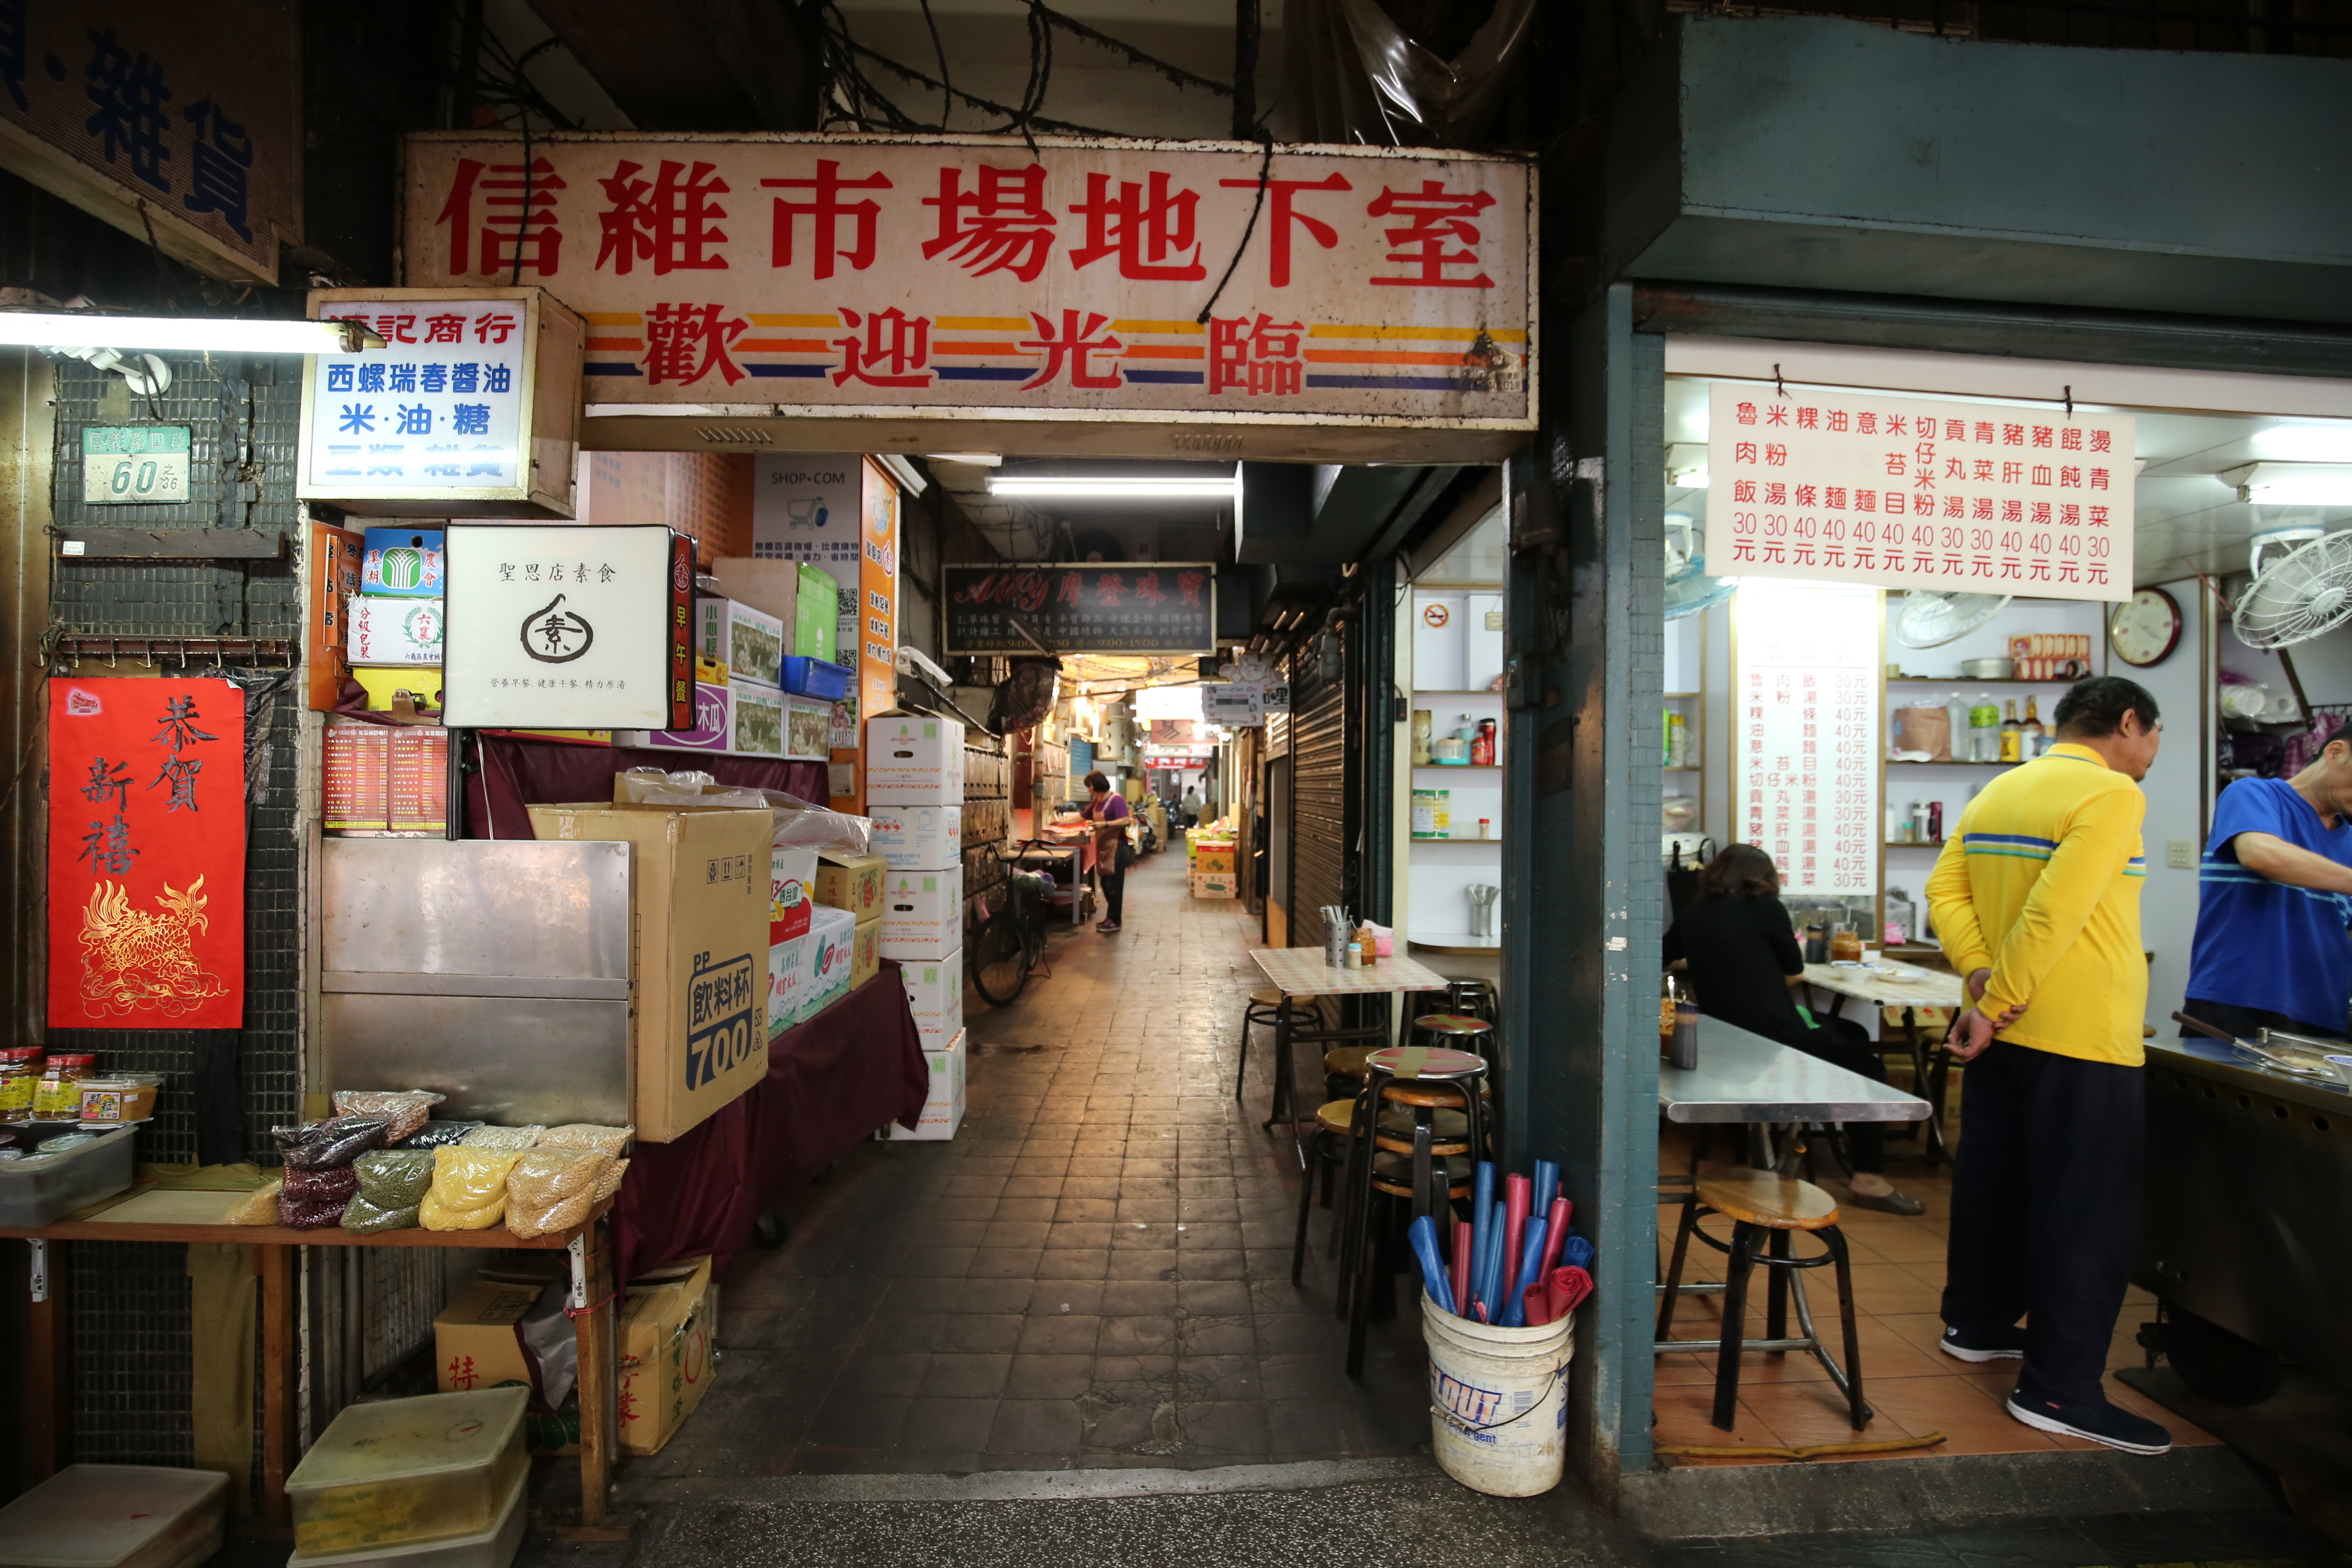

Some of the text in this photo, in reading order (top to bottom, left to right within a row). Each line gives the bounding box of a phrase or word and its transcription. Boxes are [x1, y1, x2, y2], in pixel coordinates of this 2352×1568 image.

[435, 157, 1497, 287] 信維市場地下室
[641, 303, 1305, 396] 歡迎光臨
[328, 363, 510, 393] 西螺瑞春醬油
[88, 431, 184, 450] 信義路四段
[1735, 402, 1757, 503] 魯肉飯
[1765, 405, 1788, 505] 米粉湯
[1795, 407, 1818, 507] 粿條
[1825, 410, 1848, 510] 油麵
[111, 461, 178, 494] 60 之 36
[1855, 412, 1877, 512] 意麵
[1886, 415, 1907, 514] 米苔目
[1914, 417, 1936, 516] 切仔米粉
[1944, 419, 1966, 518] 貢丸湯
[1973, 422, 1994, 520] 青菜湯
[2002, 424, 2024, 522] 豬肝湯
[2031, 426, 2052, 524] 豬血湯
[2060, 428, 2082, 526] 餛飩湯
[2089, 430, 2110, 527] 燙青菜
[366, 549, 381, 585] 溪湖
[423, 552, 437, 588] 農會
[499, 563, 617, 583] 聖恩店素食
[359, 607, 371, 659] 分級包裝
[417, 614, 431, 640] 六農
[535, 615, 583, 654] 素
[676, 606, 687, 703] 早午餐
[1749, 674, 1817, 688] 魯肉飯
[1749, 690, 1817, 704] 米粉湯
[696, 702, 720, 733] 木瓜
[1749, 707, 1817, 721] 粿條
[1749, 724, 1817, 737] 油麵
[147, 694, 219, 813] 恭賀
[1749, 740, 1817, 754] 意麵
[1749, 757, 1817, 771] 米苔目
[1749, 773, 1817, 787] 切仔米粉
[1749, 790, 1817, 804] 貢丸湯
[77, 757, 140, 876] 新禧
[1749, 806, 1817, 820] 青菜湯
[1749, 823, 1817, 837] 豬肝湯
[693, 951, 710, 973] PP
[693, 965, 751, 1027] 飲料杯
[691, 1018, 748, 1091] 700
[89, 1094, 113, 1111] 顆粒
[449, 1356, 479, 1390] 特
